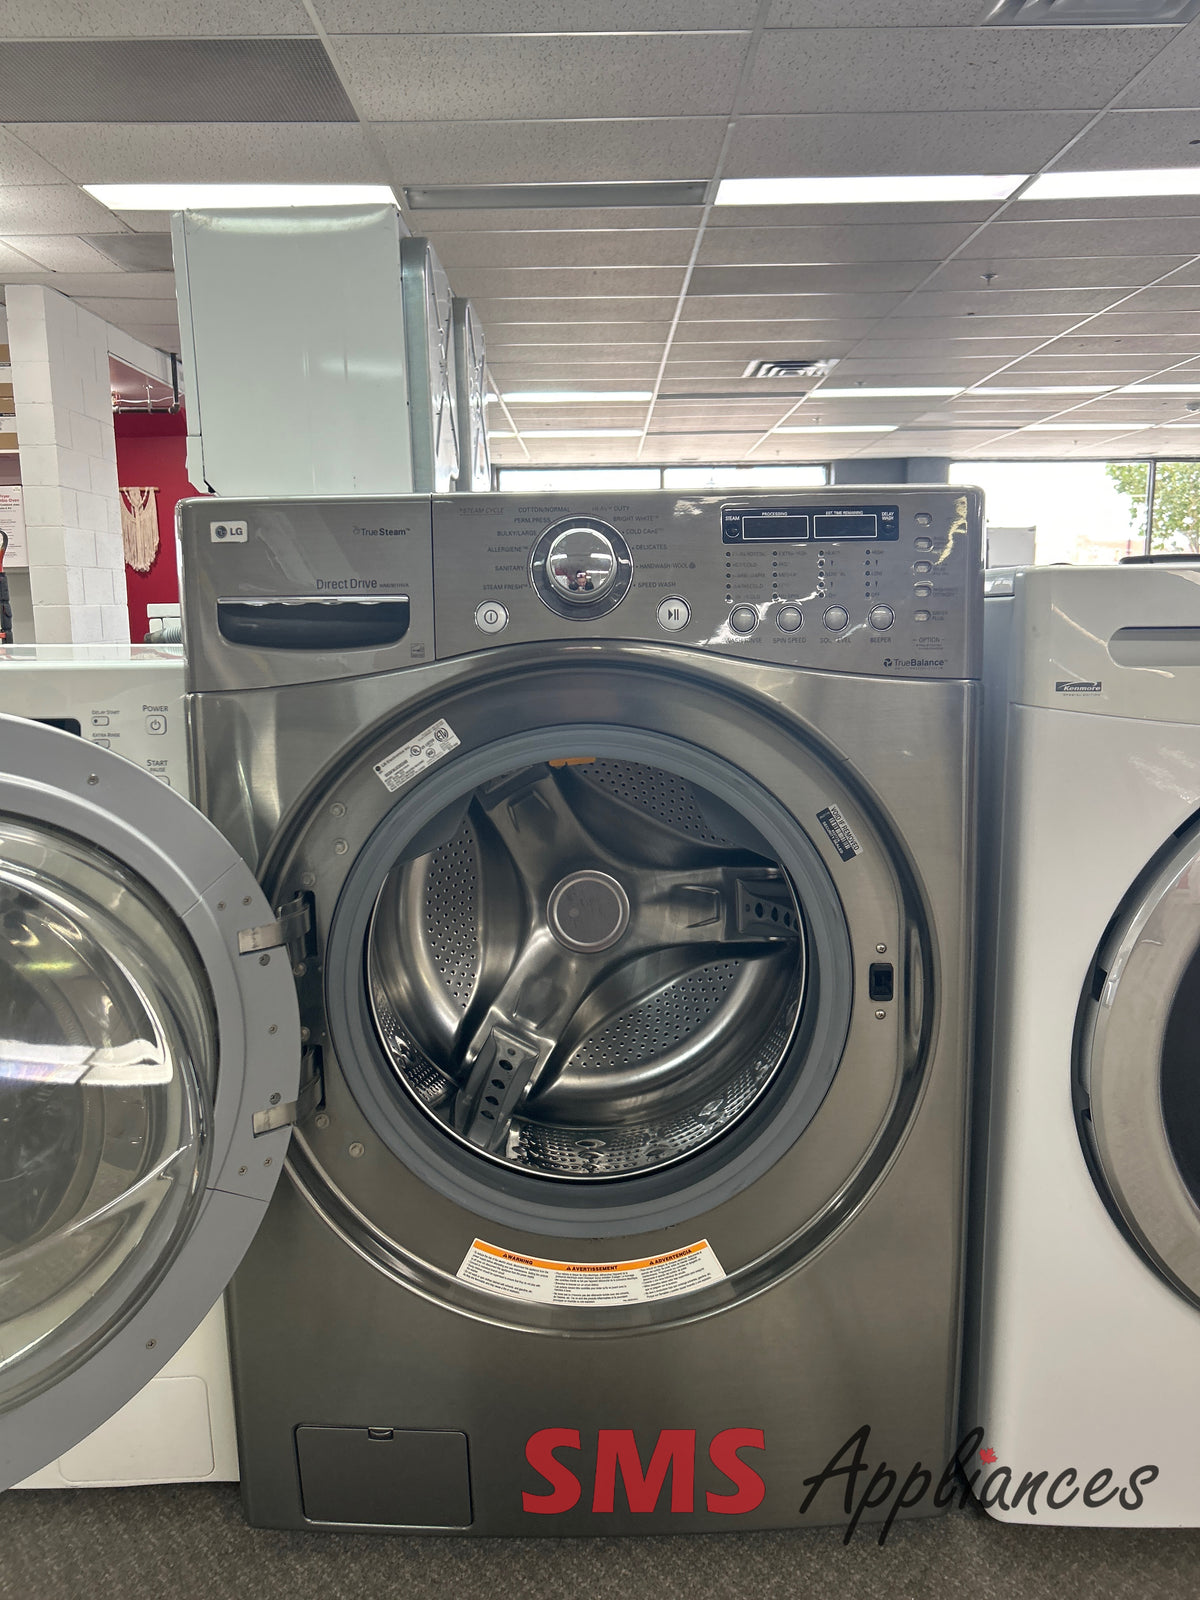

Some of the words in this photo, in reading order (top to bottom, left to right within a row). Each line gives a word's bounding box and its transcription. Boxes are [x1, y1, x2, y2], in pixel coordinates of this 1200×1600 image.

[230, 527, 243, 536] LG
[316, 578, 348, 590] Direct
[349, 578, 378, 589] Drive
[146, 759, 168, 767] START
[831, 806, 842, 821] VOID
[841, 825, 860, 851] REMOVED
[508, 1255, 533, 1265] WARNING
[654, 1249, 692, 1264] ADVERTENCIA
